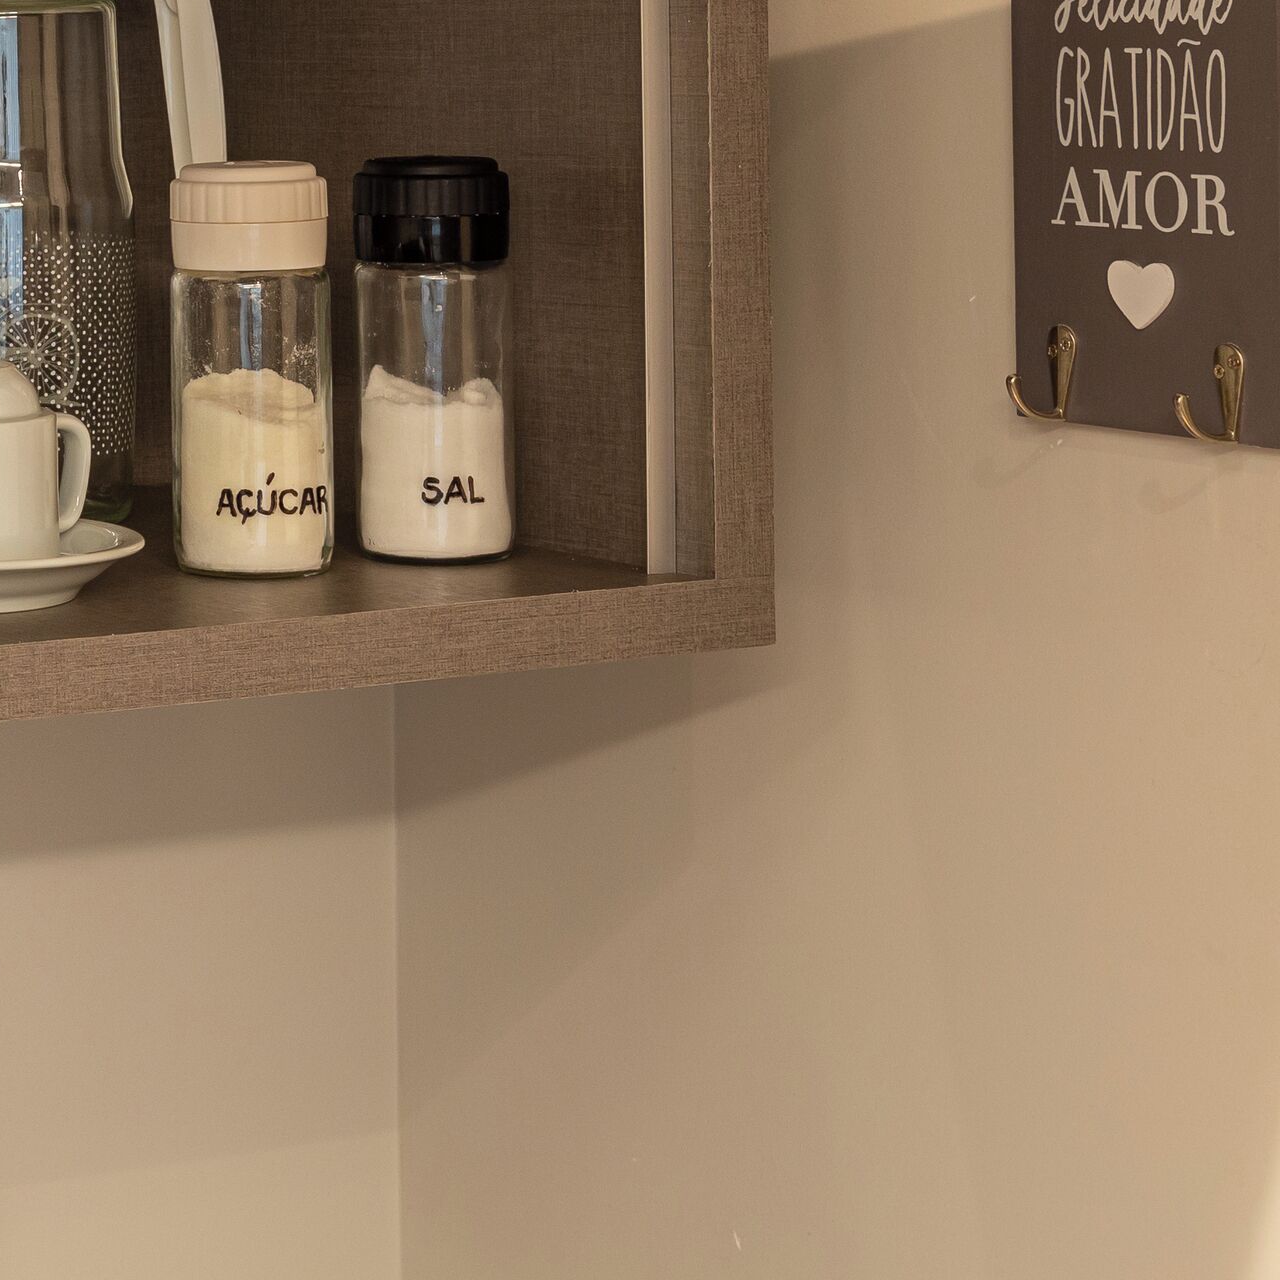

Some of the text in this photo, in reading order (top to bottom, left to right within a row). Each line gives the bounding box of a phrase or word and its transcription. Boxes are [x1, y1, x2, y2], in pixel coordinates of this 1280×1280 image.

[1055, 38, 1227, 153] GRATIDÃO
[1051, 166, 1235, 237] AMOR
[216, 472, 328, 525] AÇÚCAR
[421, 476, 485, 506] SAL
